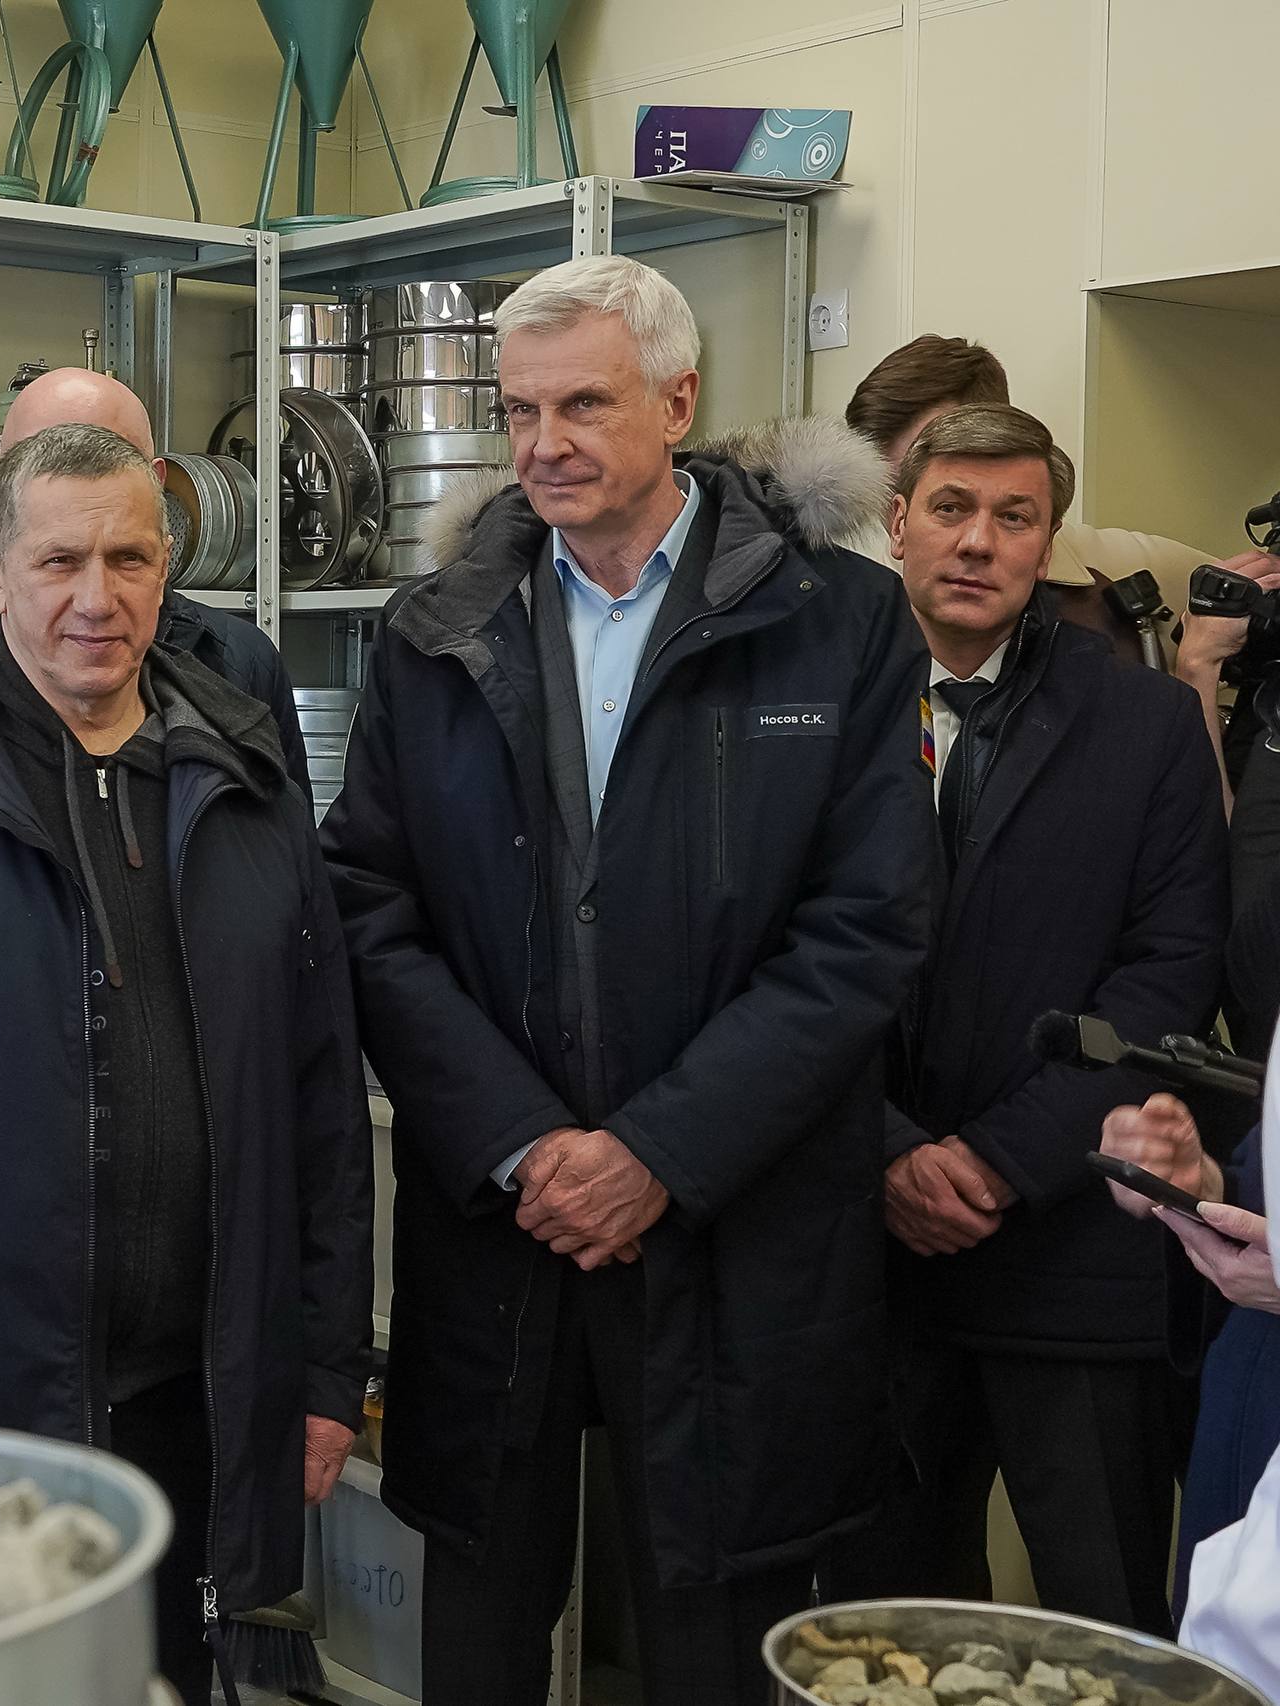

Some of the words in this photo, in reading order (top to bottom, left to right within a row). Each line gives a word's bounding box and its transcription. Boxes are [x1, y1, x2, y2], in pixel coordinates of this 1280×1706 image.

[668, 131, 687, 173] ПА
[759, 715, 799, 726] Носов
[801, 714, 826, 725] С.К.
